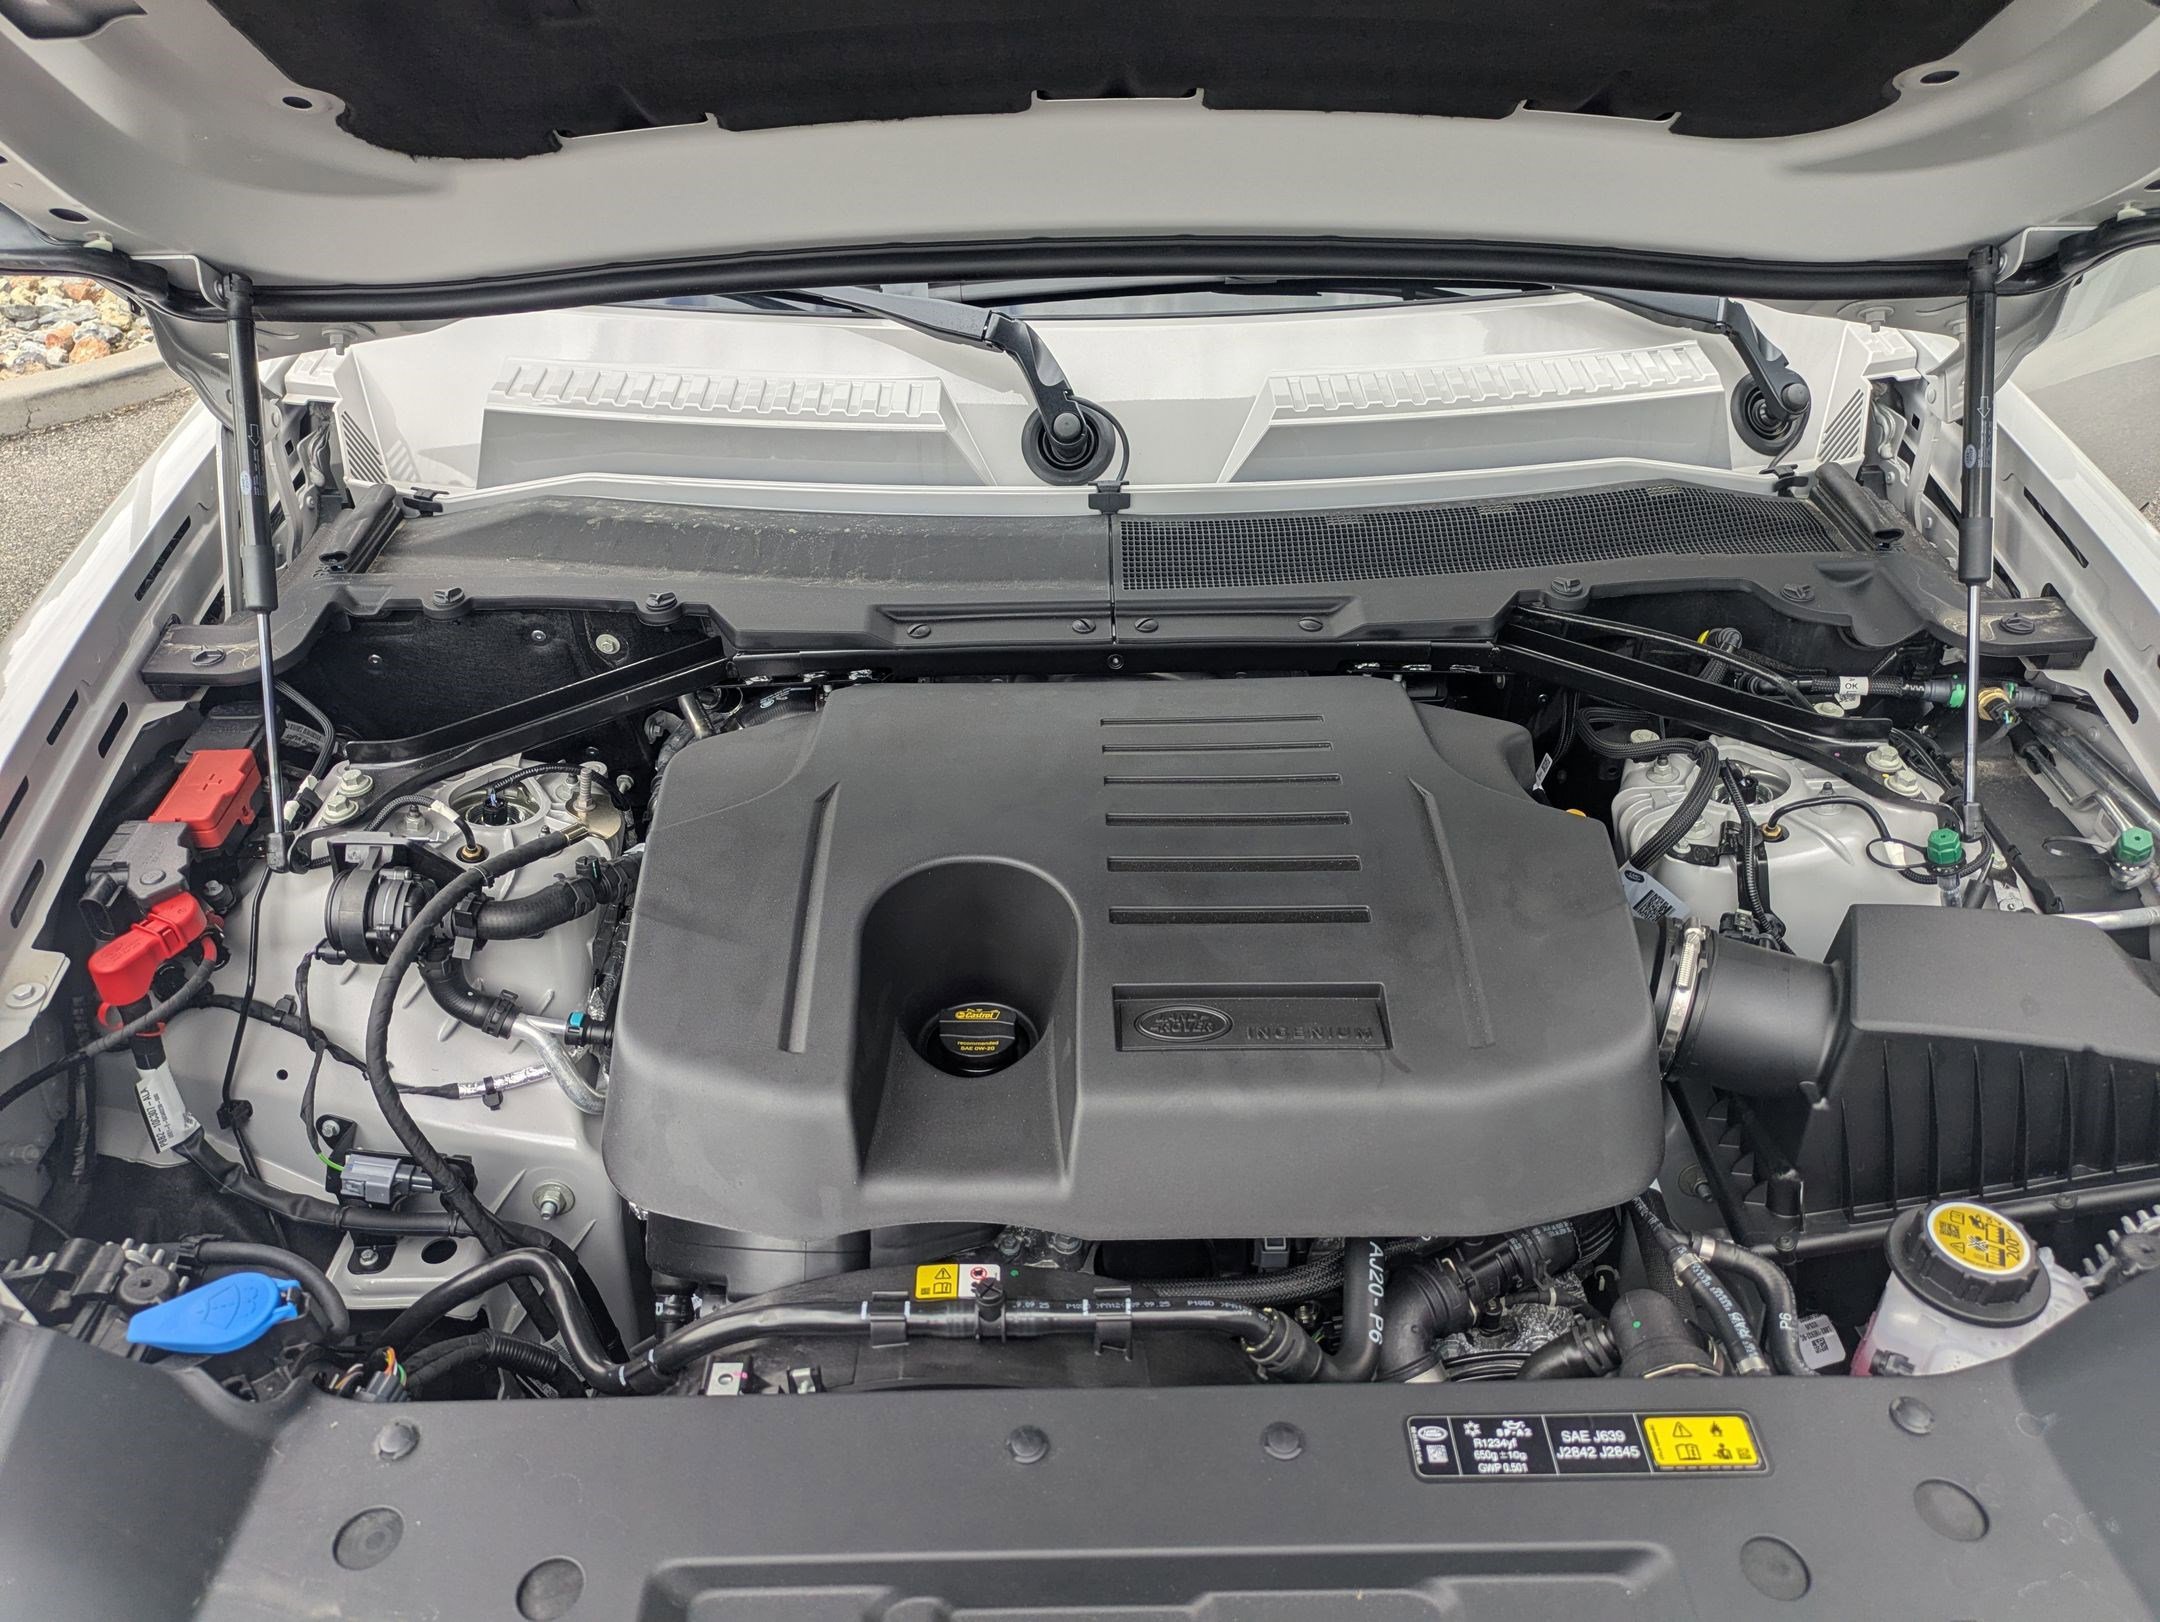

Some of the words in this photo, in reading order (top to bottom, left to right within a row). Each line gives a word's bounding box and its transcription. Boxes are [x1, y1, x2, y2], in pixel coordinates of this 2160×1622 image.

[1844, 682, 1858, 690] OK
[1159, 1021, 1214, 1033] ROVER
[1246, 1026, 1374, 1040] INGENIUM
[1779, 1312, 1792, 1330] P6
[1560, 1430, 1592, 1443] SAE
[1593, 1429, 1626, 1443] J639
[1472, 1437, 1518, 1450] R1234yf
[1473, 1449, 1499, 1462] 650g
[1556, 1446, 1598, 1459] J2842
[1599, 1445, 1641, 1459] J2845
[1477, 1462, 1502, 1474] GWP
[1502, 1462, 1529, 1474] 0.501
